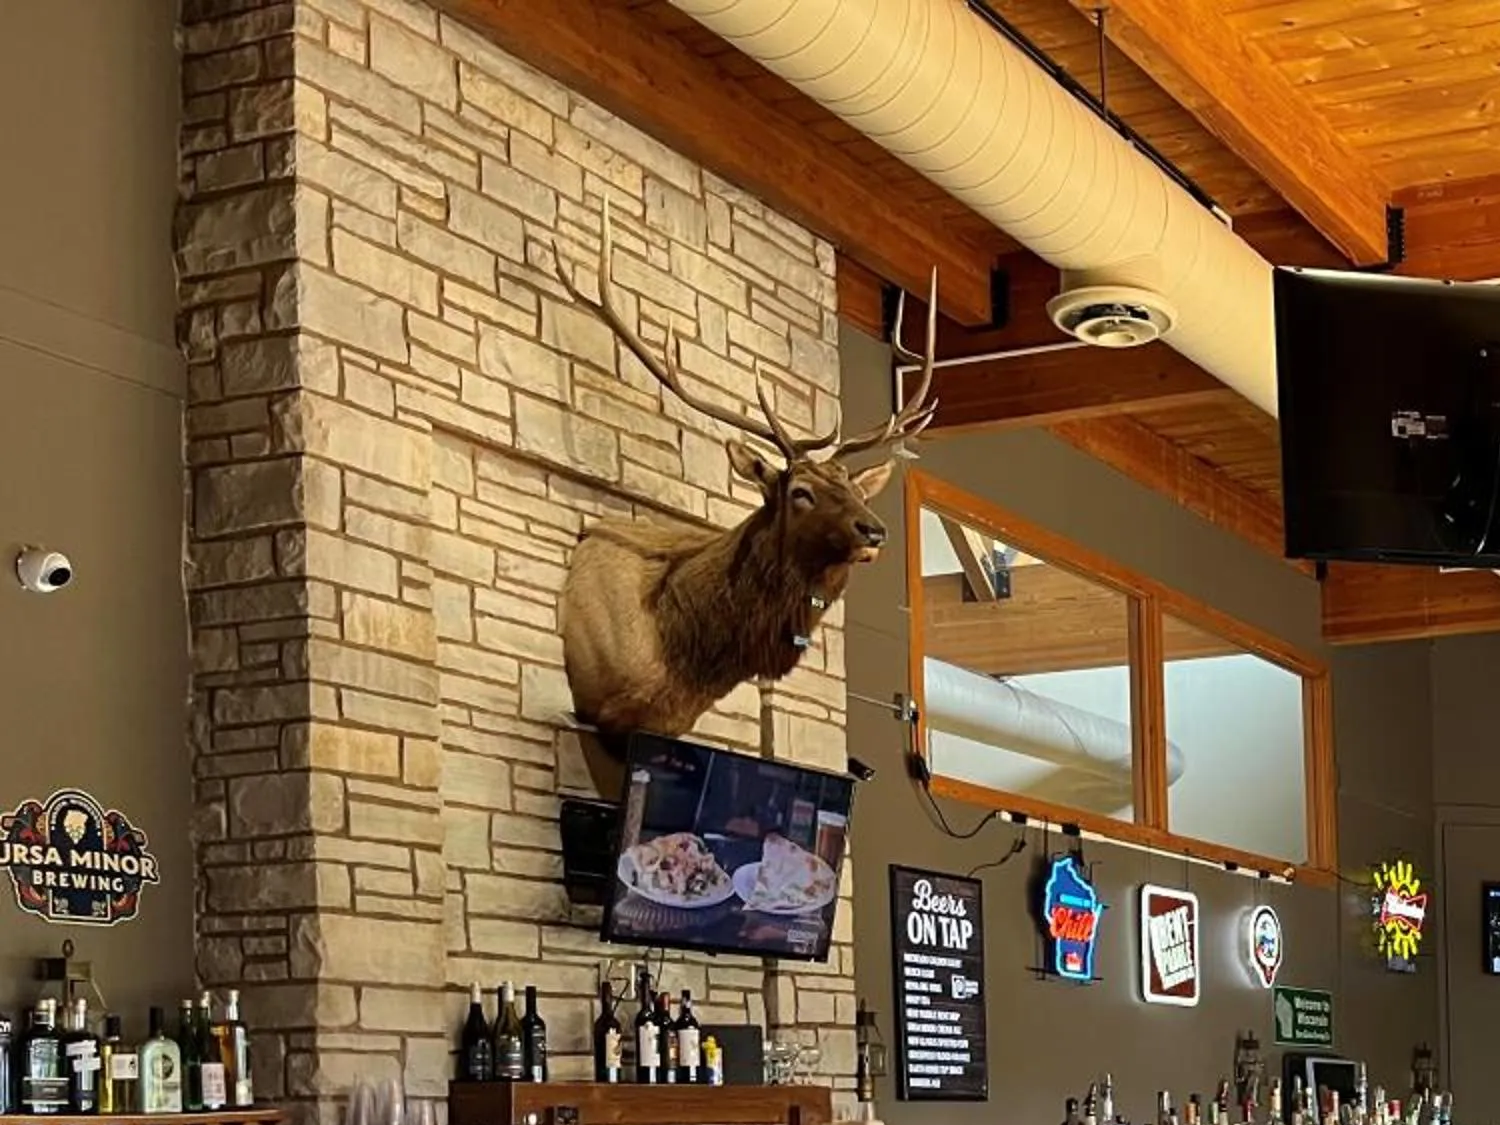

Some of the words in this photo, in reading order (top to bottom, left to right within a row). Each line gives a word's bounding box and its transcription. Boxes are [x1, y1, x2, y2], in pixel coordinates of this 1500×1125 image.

[71, 850, 155, 878] MINOR
[32, 870, 125, 892] BREWING
[912, 879, 967, 917] Beers
[907, 911, 937, 946] ON
[938, 915, 973, 950] TAP
